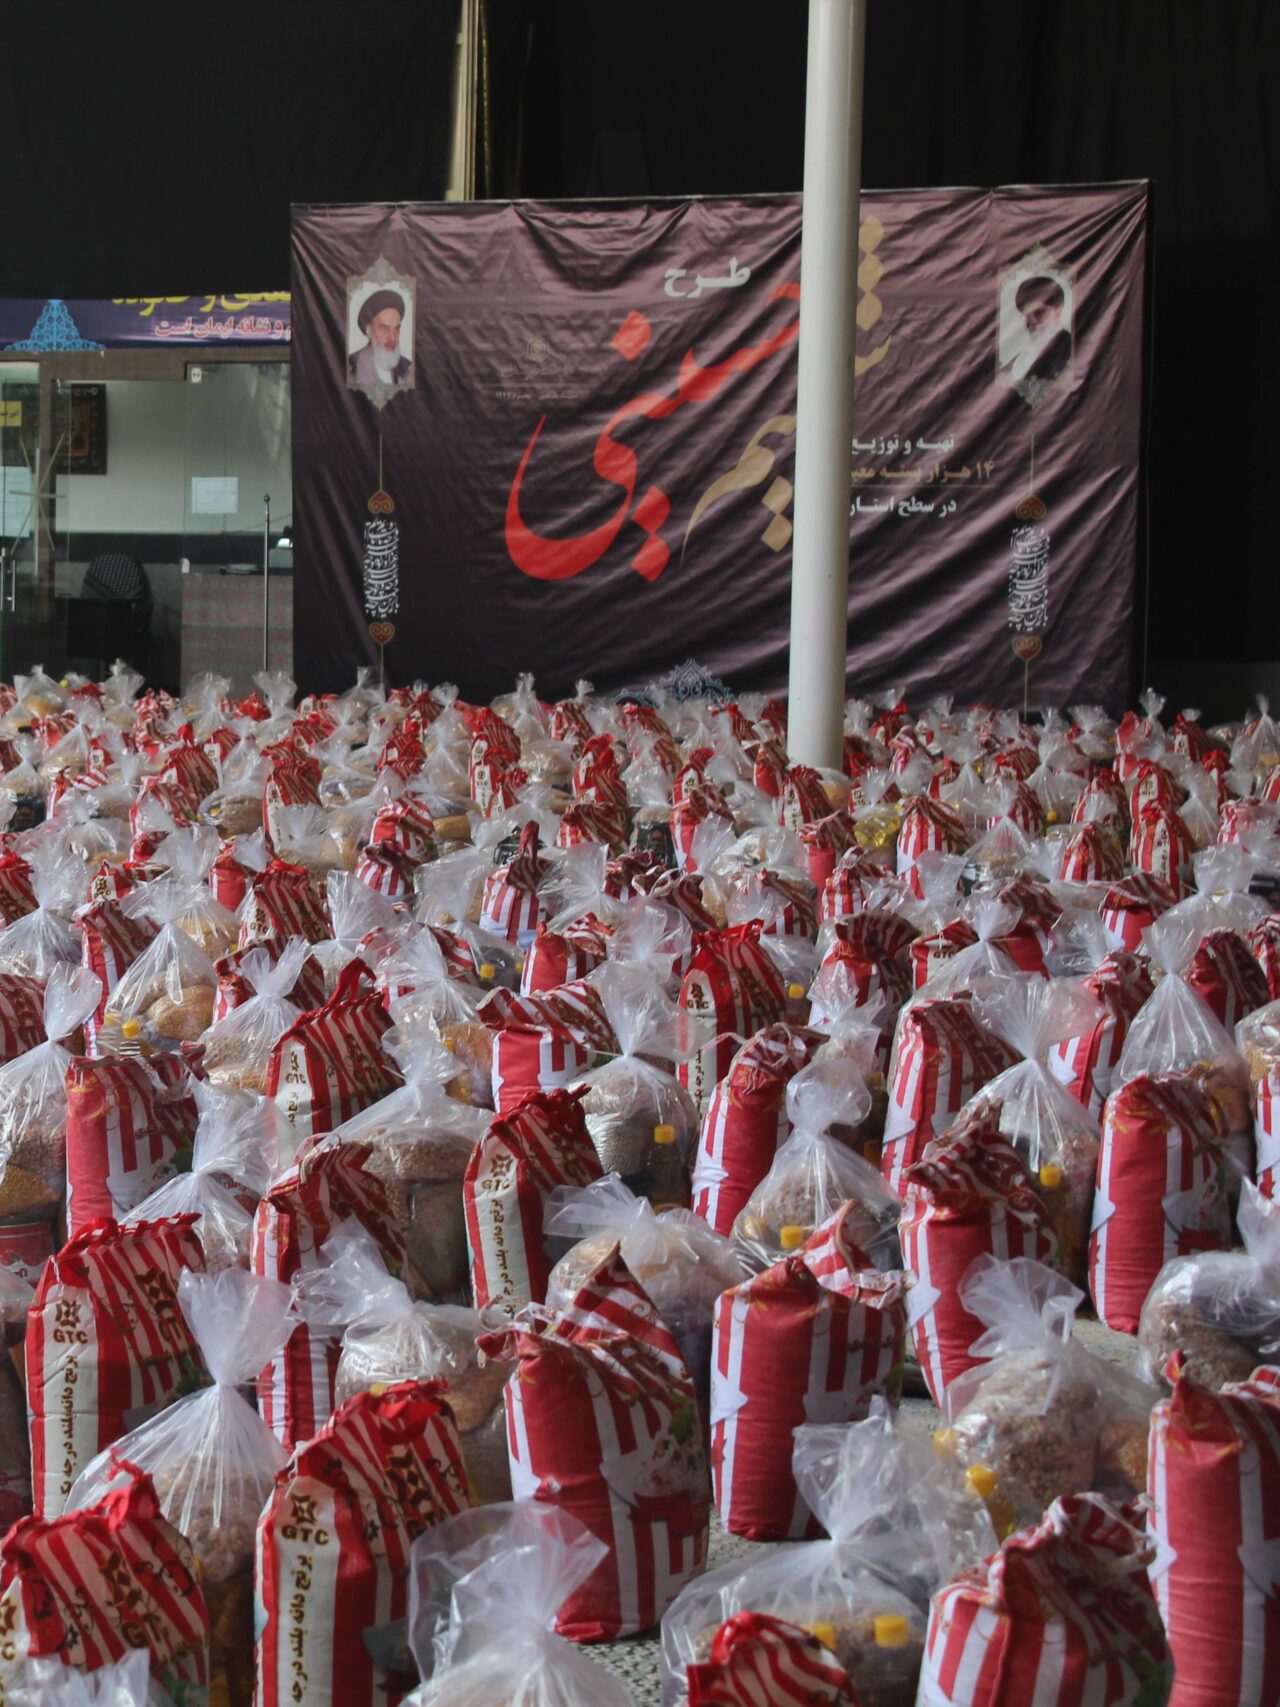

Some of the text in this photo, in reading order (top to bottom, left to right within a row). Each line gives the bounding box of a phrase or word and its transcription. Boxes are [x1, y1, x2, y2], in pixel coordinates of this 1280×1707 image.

[663, 256, 753, 299] طرح
[154, 315, 193, 337] است
[193, 315, 235, 339] ایمان
[904, 438, 912, 455] و
[915, 433, 956, 453] تهیه
[925, 464, 972, 484] هزار
[897, 496, 934, 516] سطح
[938, 499, 957, 517] در
[489, 1199, 505, 1224] برنج
[491, 1226, 504, 1248] دانه
[495, 1249, 509, 1271] بلند
[52, 1329, 90, 1345] GTC
[63, 1355, 79, 1385] برنج
[60, 1385, 74, 1415] دانه
[60, 1415, 78, 1440] بلند
[62, 1440, 78, 1478] درجه
[281, 1524, 330, 1547] GTC
[288, 1554, 314, 1704] برنج دانه بلند درجه
